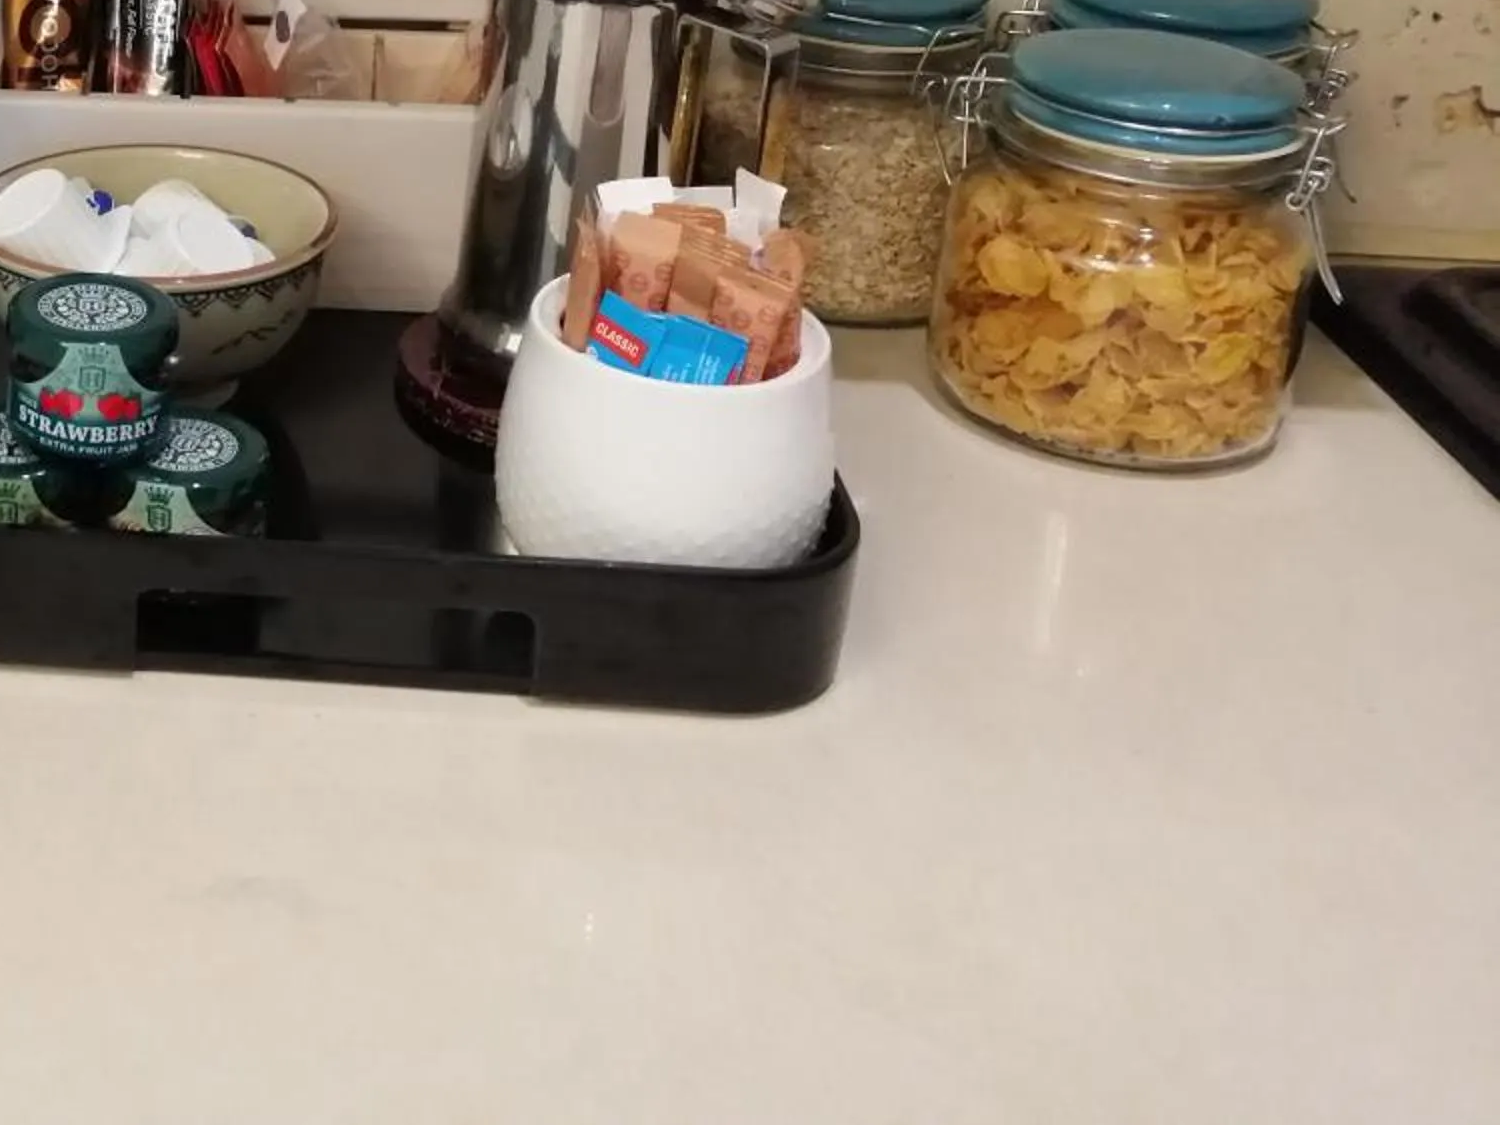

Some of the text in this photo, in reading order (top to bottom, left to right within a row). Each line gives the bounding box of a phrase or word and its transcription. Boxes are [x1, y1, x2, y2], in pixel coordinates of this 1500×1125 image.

[595, 321, 640, 358] CLASSIC
[18, 404, 159, 444] STRAWBERRY
[39, 436, 75, 453] EXTRA
[79, 445, 113, 455] FRUIT
